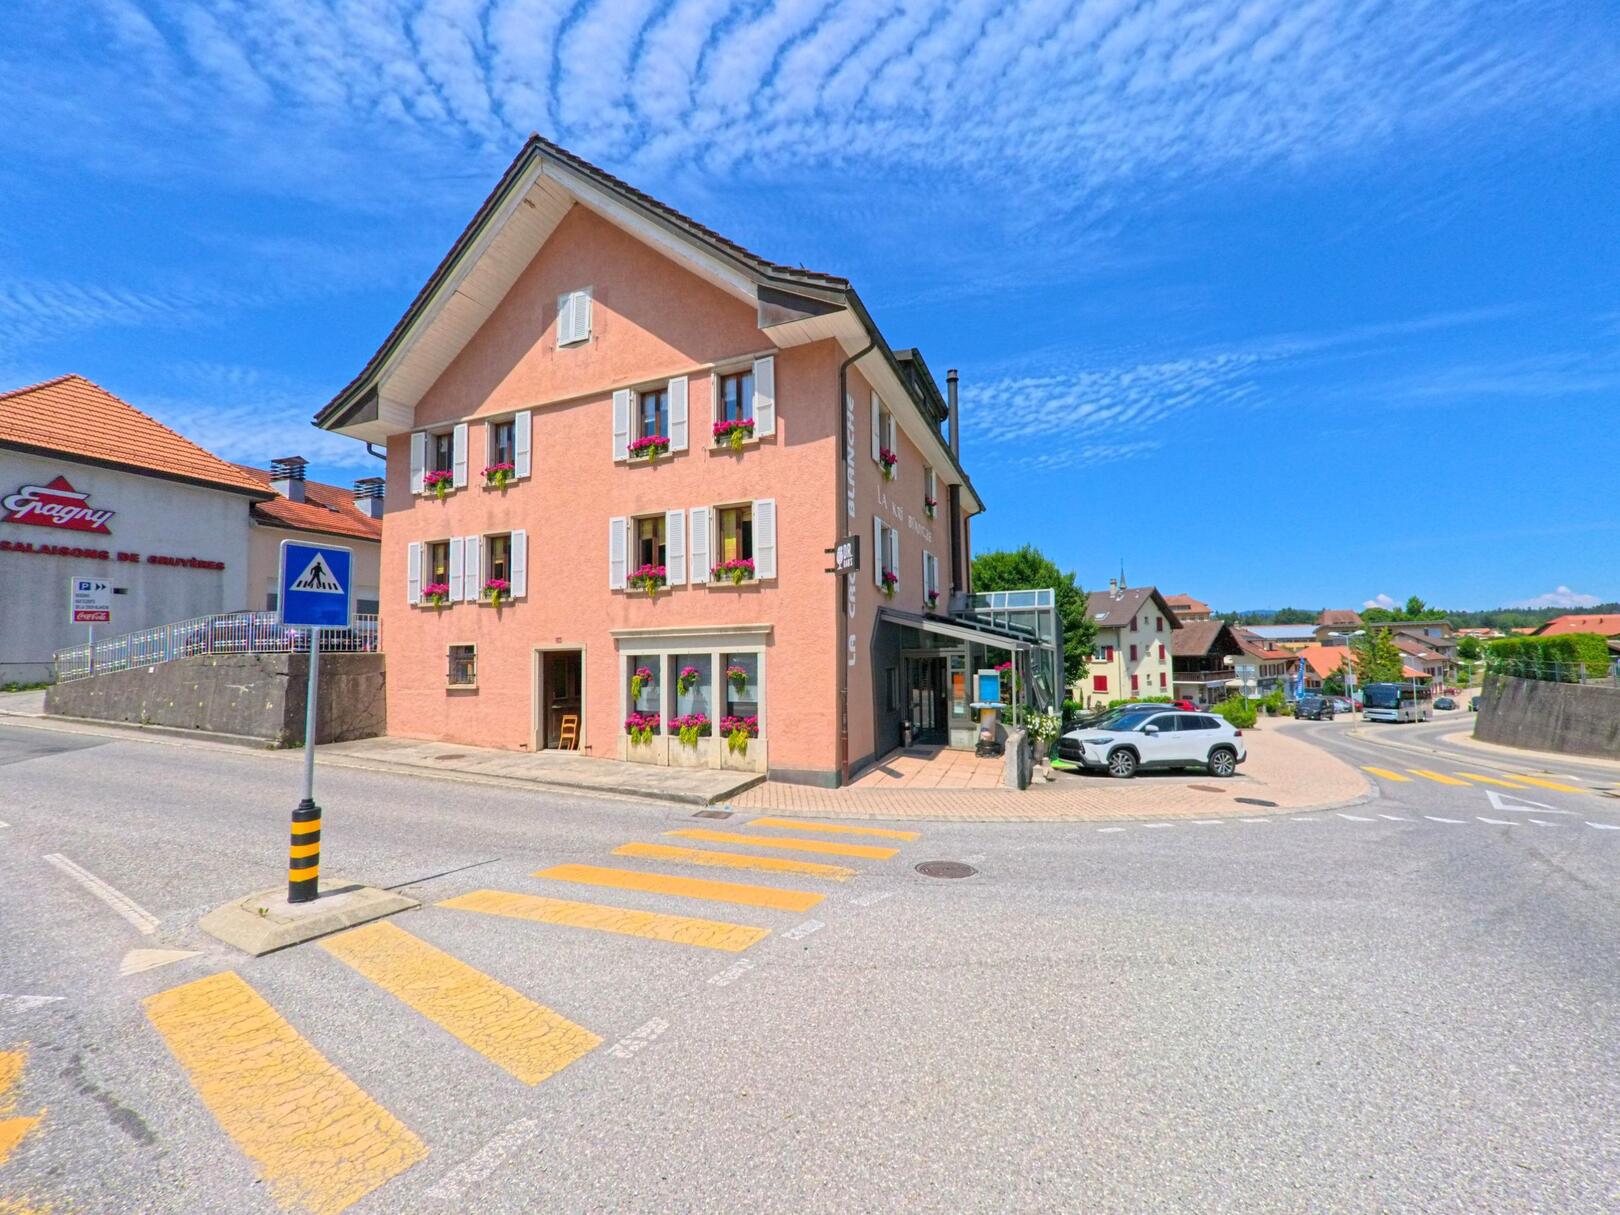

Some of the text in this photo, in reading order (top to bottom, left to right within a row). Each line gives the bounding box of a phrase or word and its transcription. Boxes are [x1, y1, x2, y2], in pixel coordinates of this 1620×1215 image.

[846, 392, 855, 518] BLANCHE
[0, 541, 110, 561] SALAISONS
[117, 552, 140, 564] DE
[848, 634, 857, 667] LA
